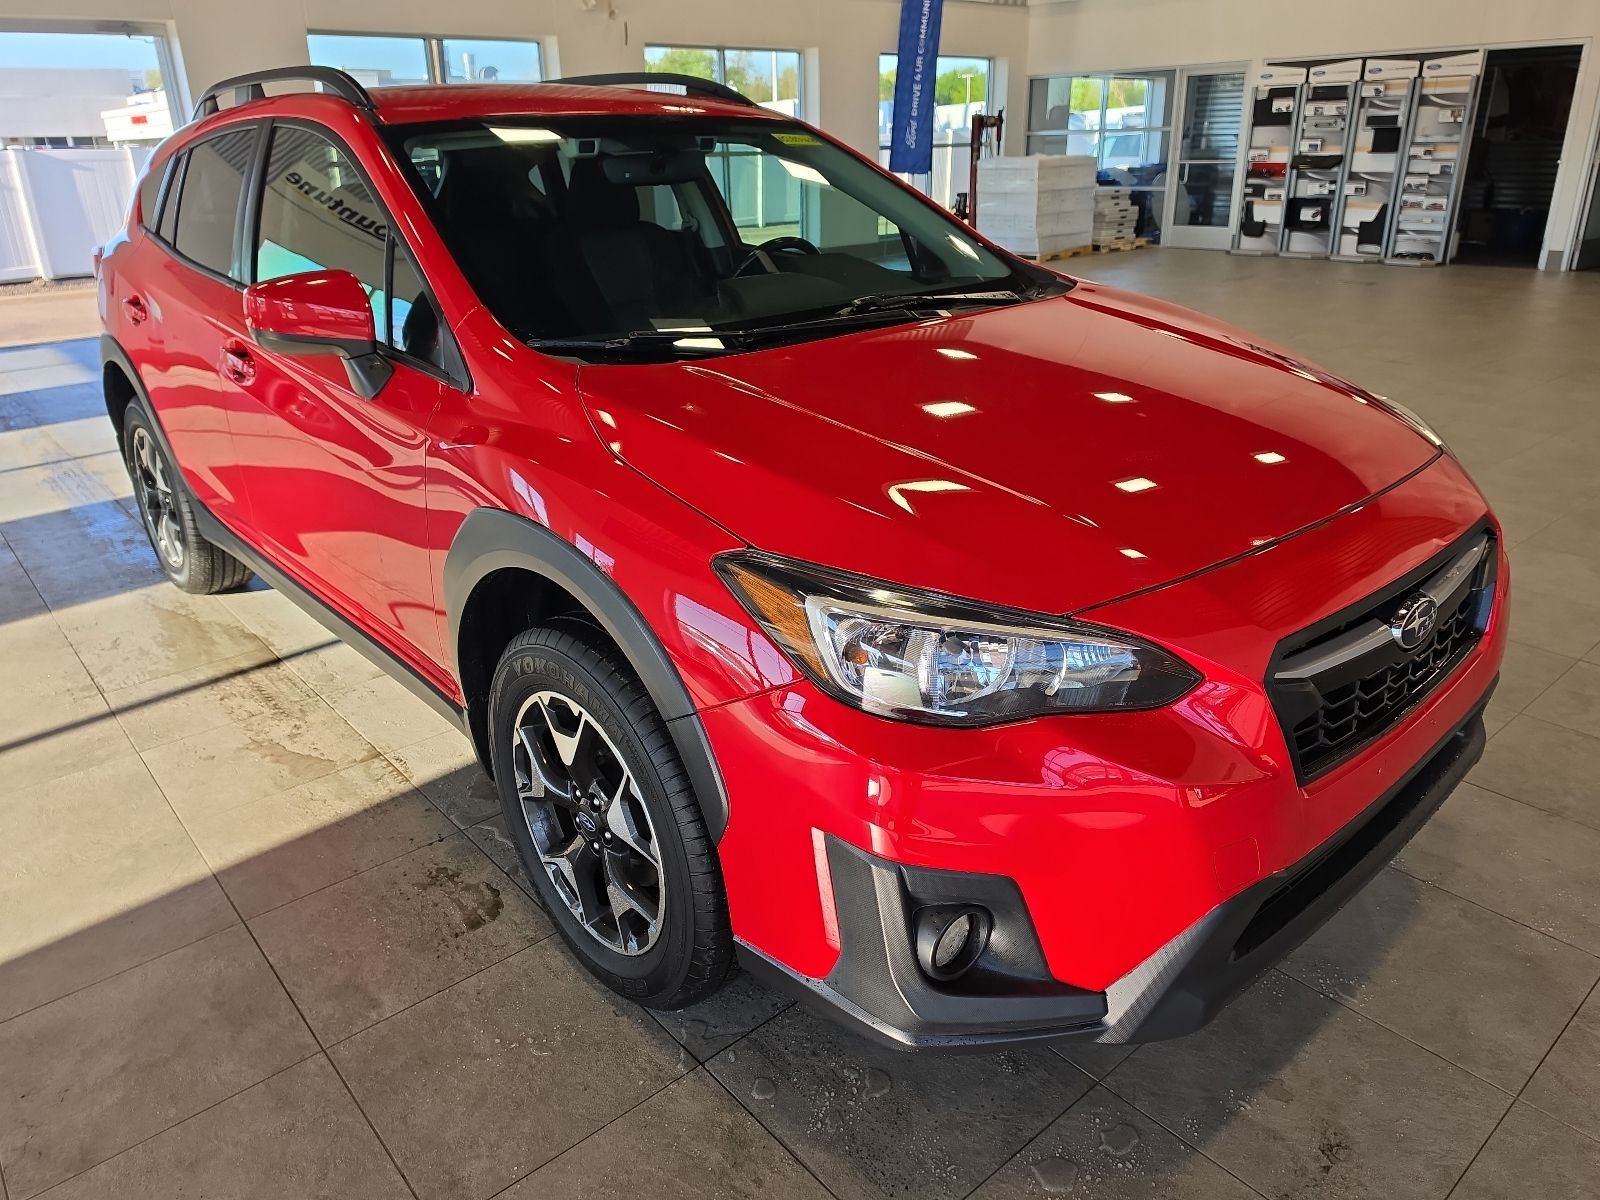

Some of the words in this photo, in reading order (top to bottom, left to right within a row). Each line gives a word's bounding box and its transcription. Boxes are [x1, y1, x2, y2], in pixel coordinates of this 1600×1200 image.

[915, 56, 924, 72] UR
[911, 83, 921, 116] DRIVE
[905, 120, 917, 149] Ford
[512, 656, 626, 746] YOKOHAMA
